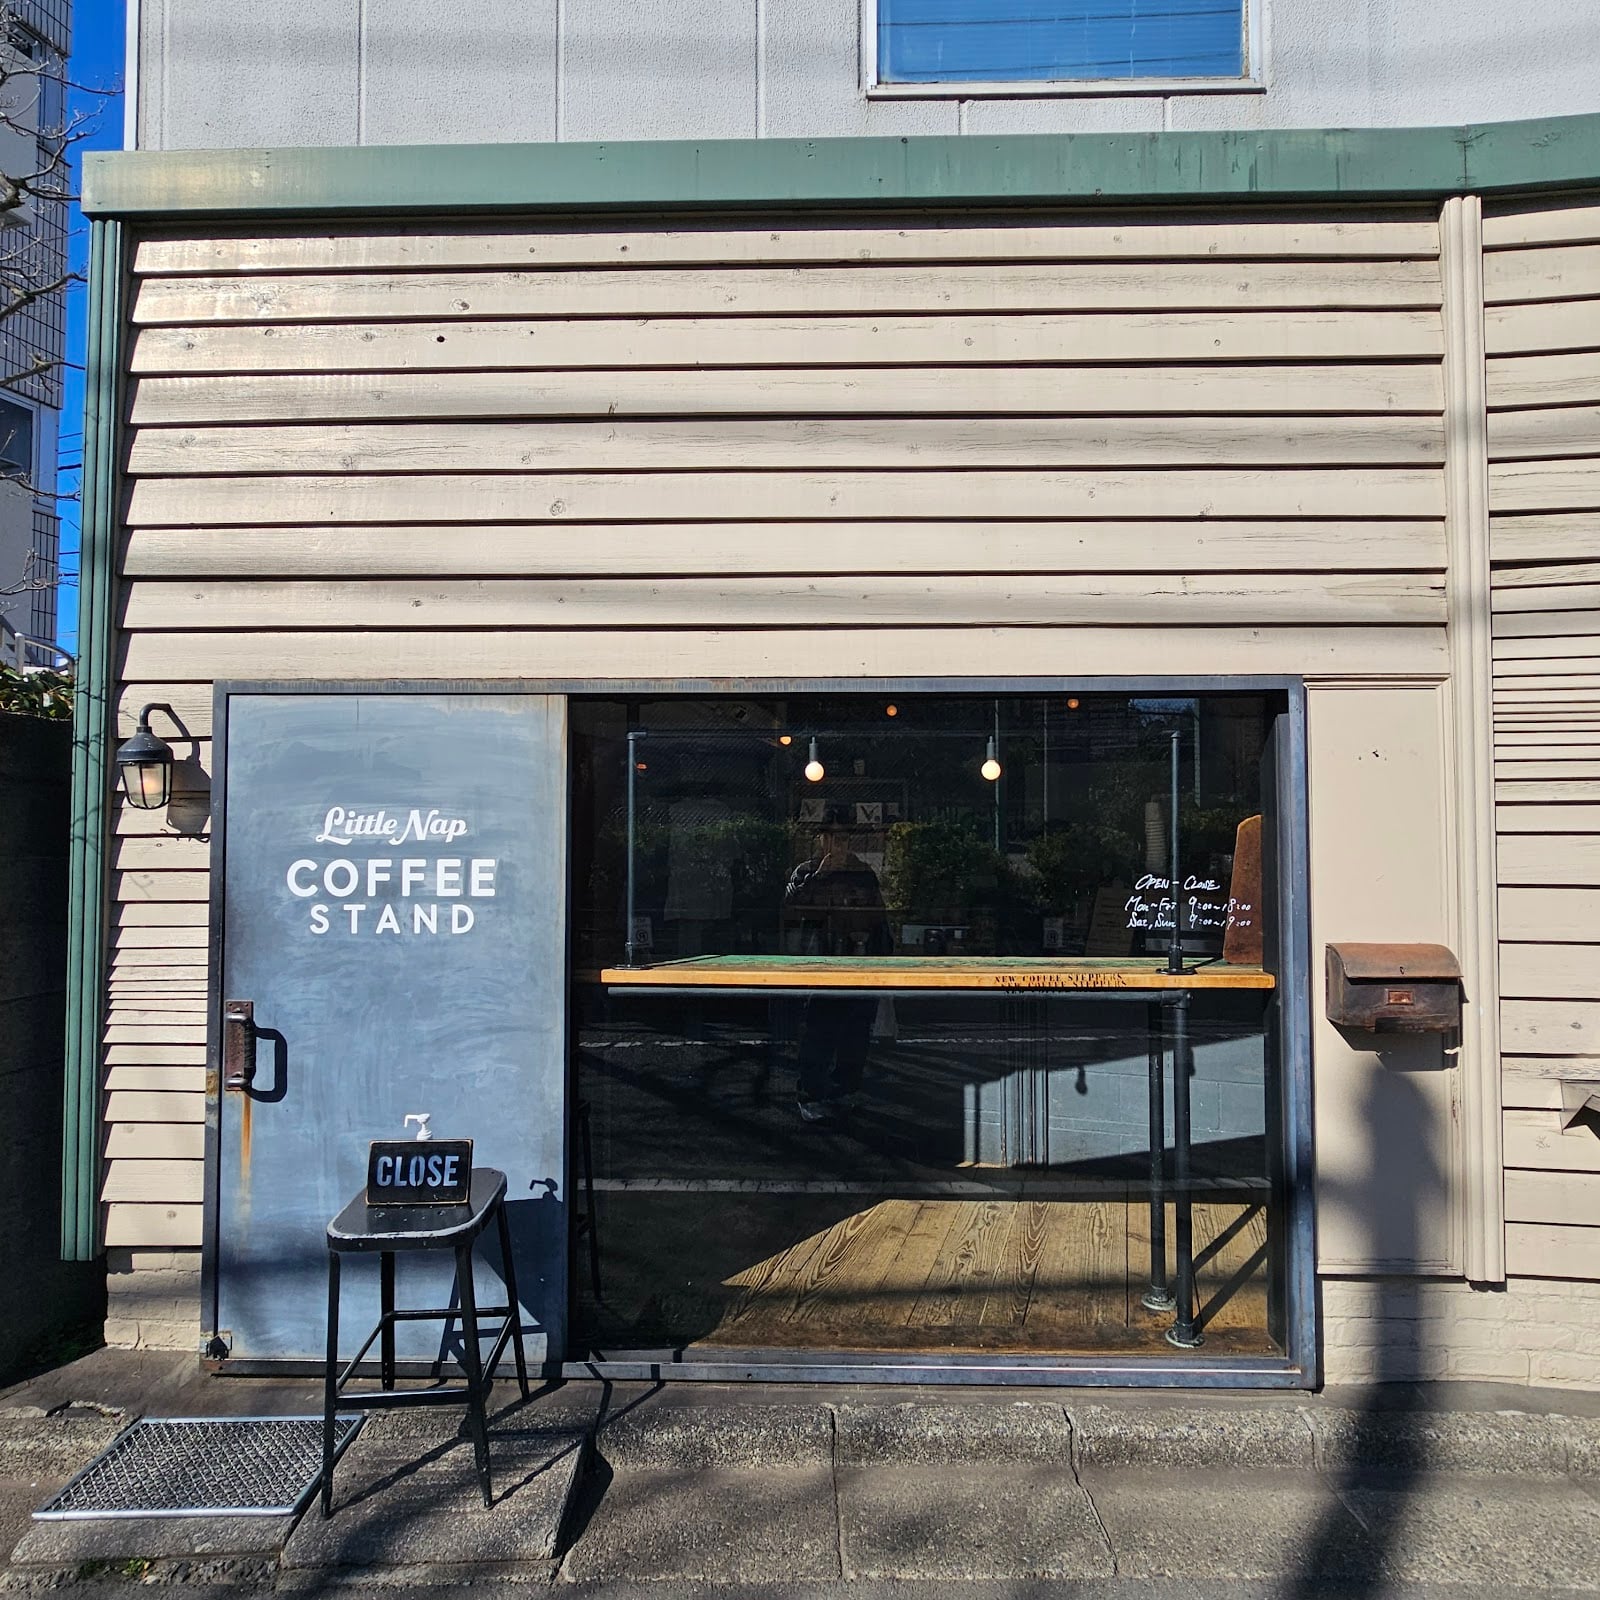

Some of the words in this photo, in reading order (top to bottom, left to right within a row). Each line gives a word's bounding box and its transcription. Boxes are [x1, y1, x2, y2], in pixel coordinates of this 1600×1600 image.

[315, 806, 397, 846] Little
[388, 809, 468, 846] Nap
[286, 858, 497, 897] COFFEE
[1134, 873, 1170, 891] OPEN
[309, 903, 475, 935] STAND
[376, 1155, 460, 1188] CLOSE
